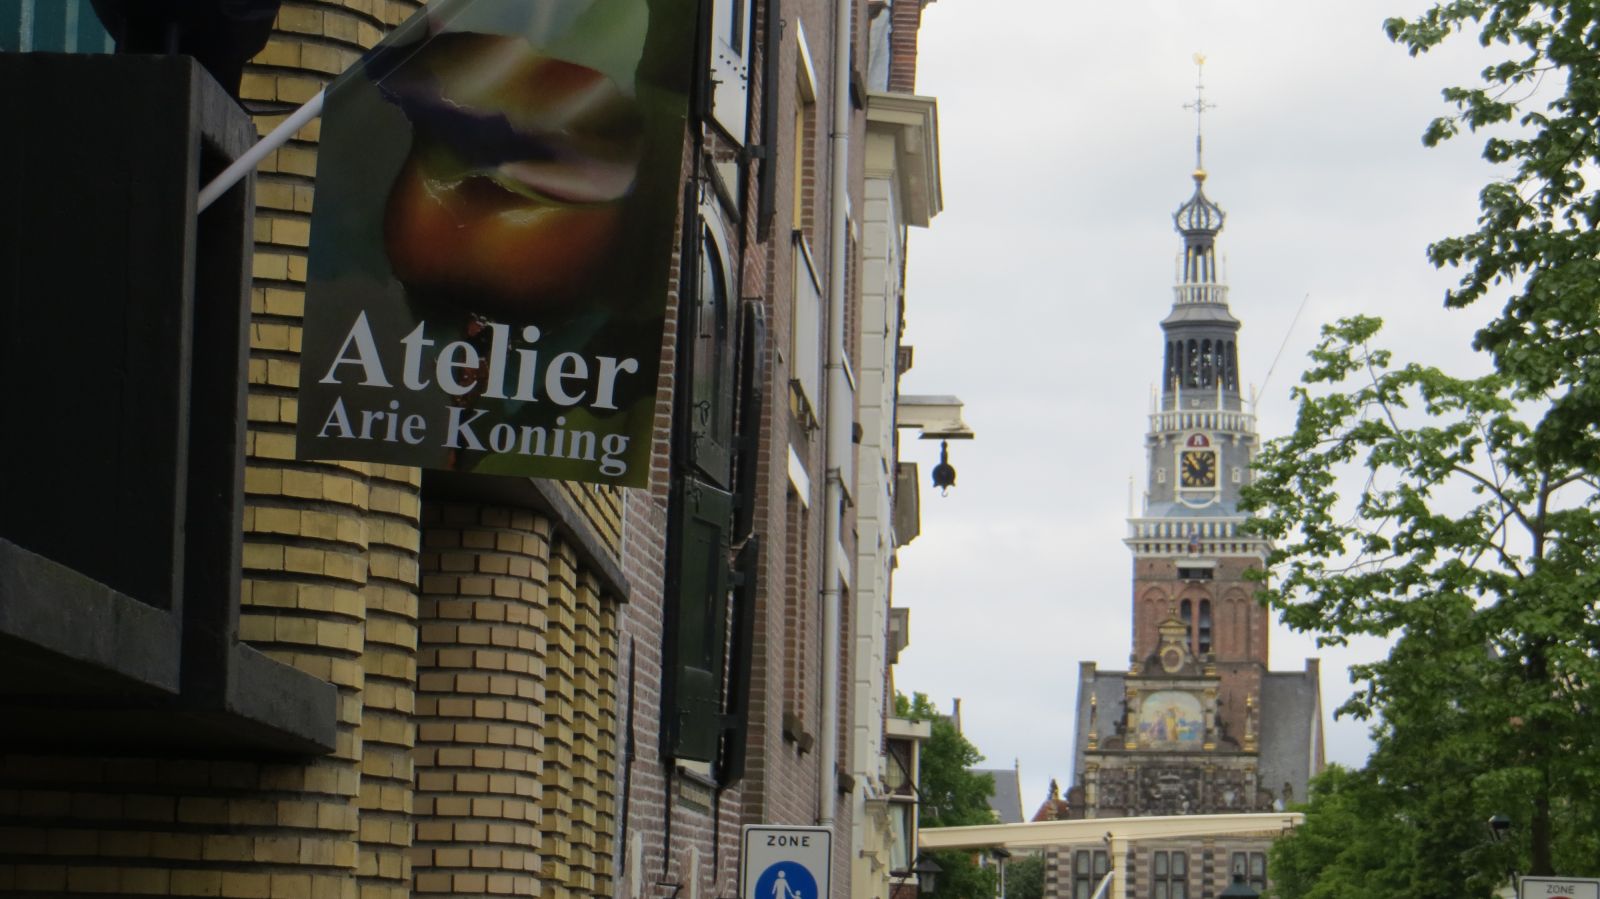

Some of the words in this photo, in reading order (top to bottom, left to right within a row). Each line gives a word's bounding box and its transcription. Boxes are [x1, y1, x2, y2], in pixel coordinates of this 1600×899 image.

[318, 309, 639, 410] Atelier
[317, 396, 427, 445] Arie
[441, 405, 630, 476] Koning
[767, 835, 810, 847] ZONE
[1546, 885, 1575, 894] ZONE
